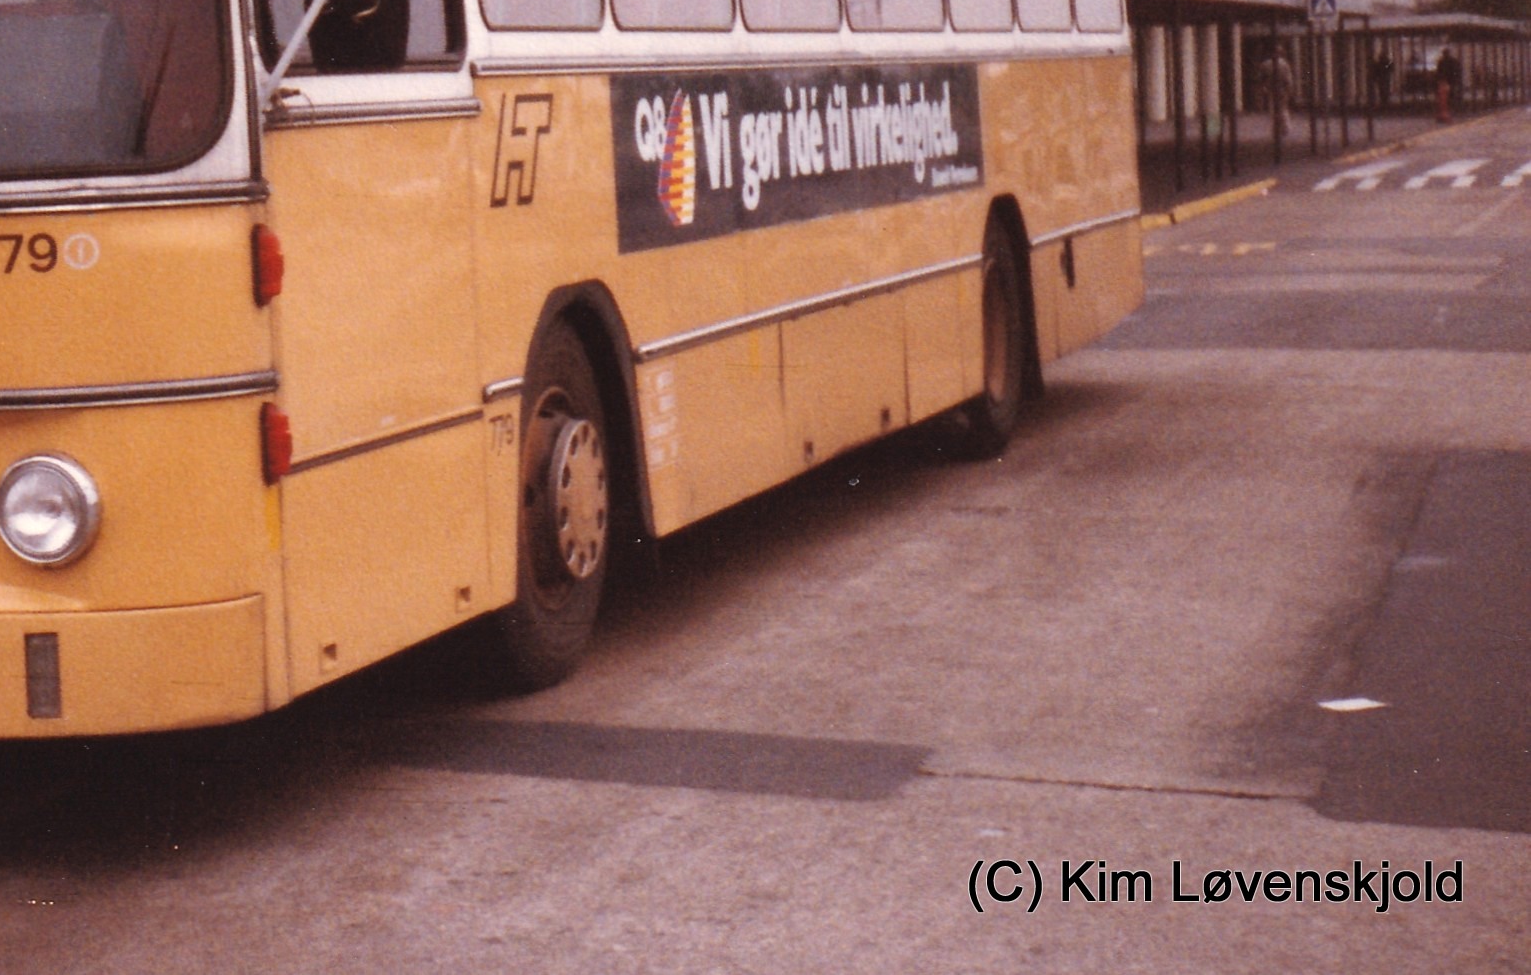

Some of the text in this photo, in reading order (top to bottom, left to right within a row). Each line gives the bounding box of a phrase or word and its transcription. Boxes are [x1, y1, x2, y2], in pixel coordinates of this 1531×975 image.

[635, 95, 667, 162] Q8
[699, 79, 958, 211] Vi gør idé til virkelighed.
